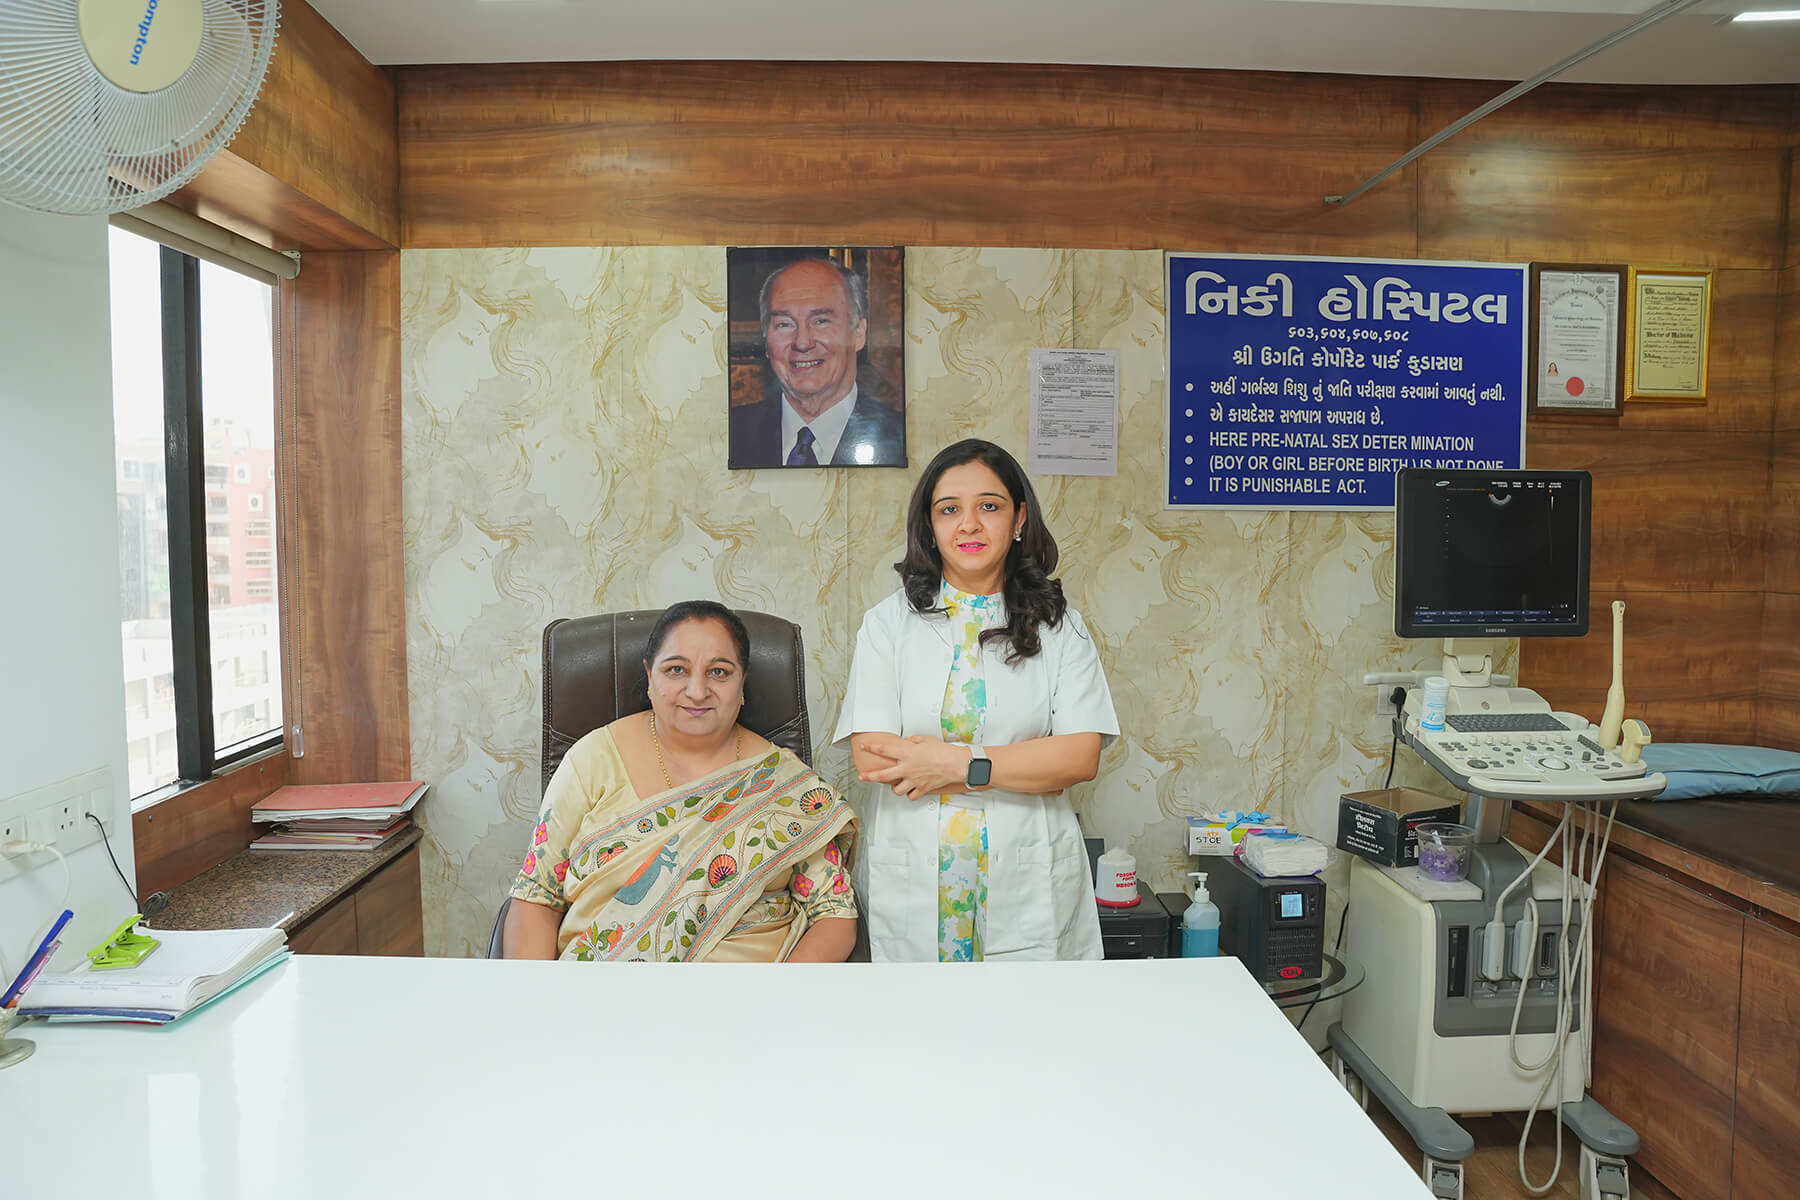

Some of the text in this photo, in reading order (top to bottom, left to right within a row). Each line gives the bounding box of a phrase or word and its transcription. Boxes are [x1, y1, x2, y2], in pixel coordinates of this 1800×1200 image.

[129, 0, 159, 65] ompton
[1185, 270, 1293, 317] નિકી
[1318, 274, 1507, 325] હોસ્પિટલ
[1232, 344, 1252, 365] શ્રી
[1261, 346, 1304, 366] ઉગતિ
[1371, 349, 1403, 369] પાર્ક
[1407, 355, 1463, 376] કુડાસણ
[1240, 377, 1278, 395] ગર્ભસ્થ
[1283, 377, 1308, 402] શિશુ
[1312, 378, 1324, 402] નું
[1327, 379, 1352, 397] જાતિ
[1356, 379, 1396, 400] પરીક્ષણ
[1400, 382, 1439, 399] કરવામાં
[1443, 383, 1477, 406] આવતું
[1210, 402, 1223, 422] એ
[1228, 402, 1274, 422] કાયદેસર
[1326, 410, 1366, 424] અપરાધ
[1210, 431, 1474, 451] HERE PRE-NATAL SEX DETER MINATION
[1209, 455, 1244, 473] (BOY
[1248, 455, 1268, 470] OR
[1272, 456, 1305, 471] GIRL
[1308, 456, 1364, 472] BEFORE
[1209, 477, 1367, 494] IT IS PUNISHABLE ACT.
